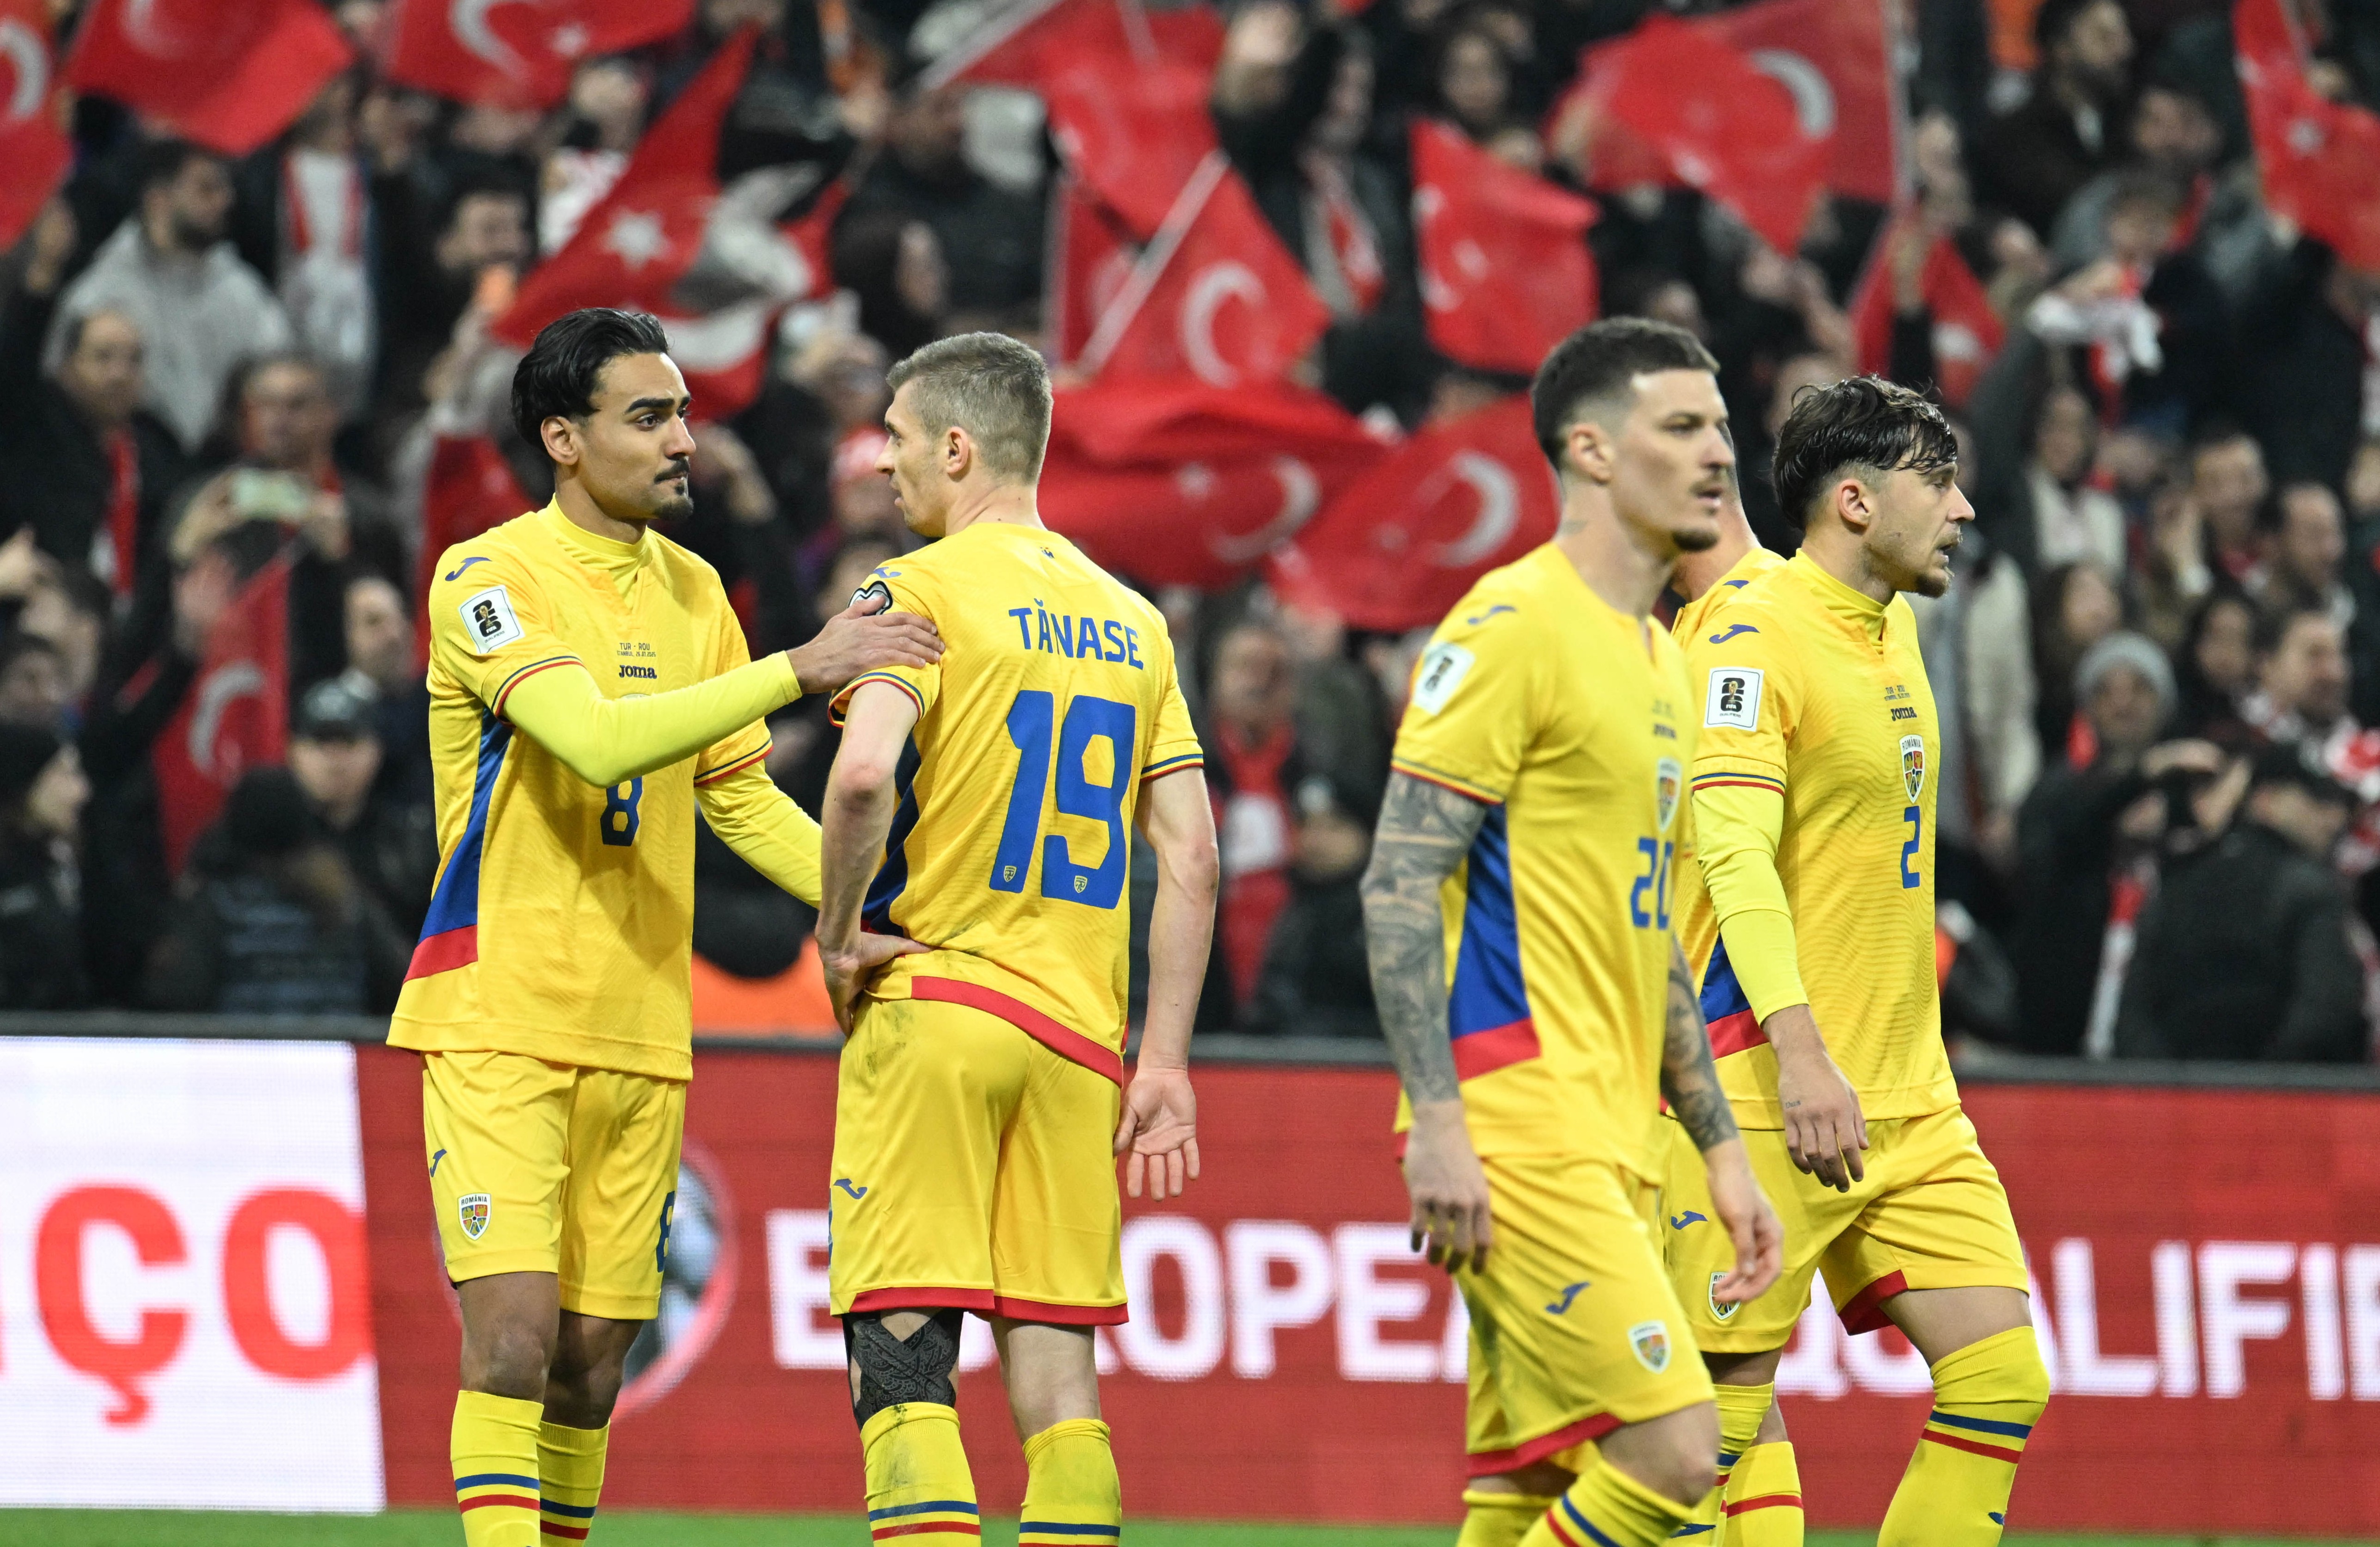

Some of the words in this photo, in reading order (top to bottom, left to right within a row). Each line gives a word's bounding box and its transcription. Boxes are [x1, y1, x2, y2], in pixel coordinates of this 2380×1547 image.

[1009, 598, 1144, 670] TĂNASE
[600, 776, 643, 847] 8
[989, 689, 1136, 910] 19
[1900, 805, 1921, 889] 2
[461, 1195, 487, 1206] ROMÂNIA
[0, 1183, 373, 1424] ÇO
